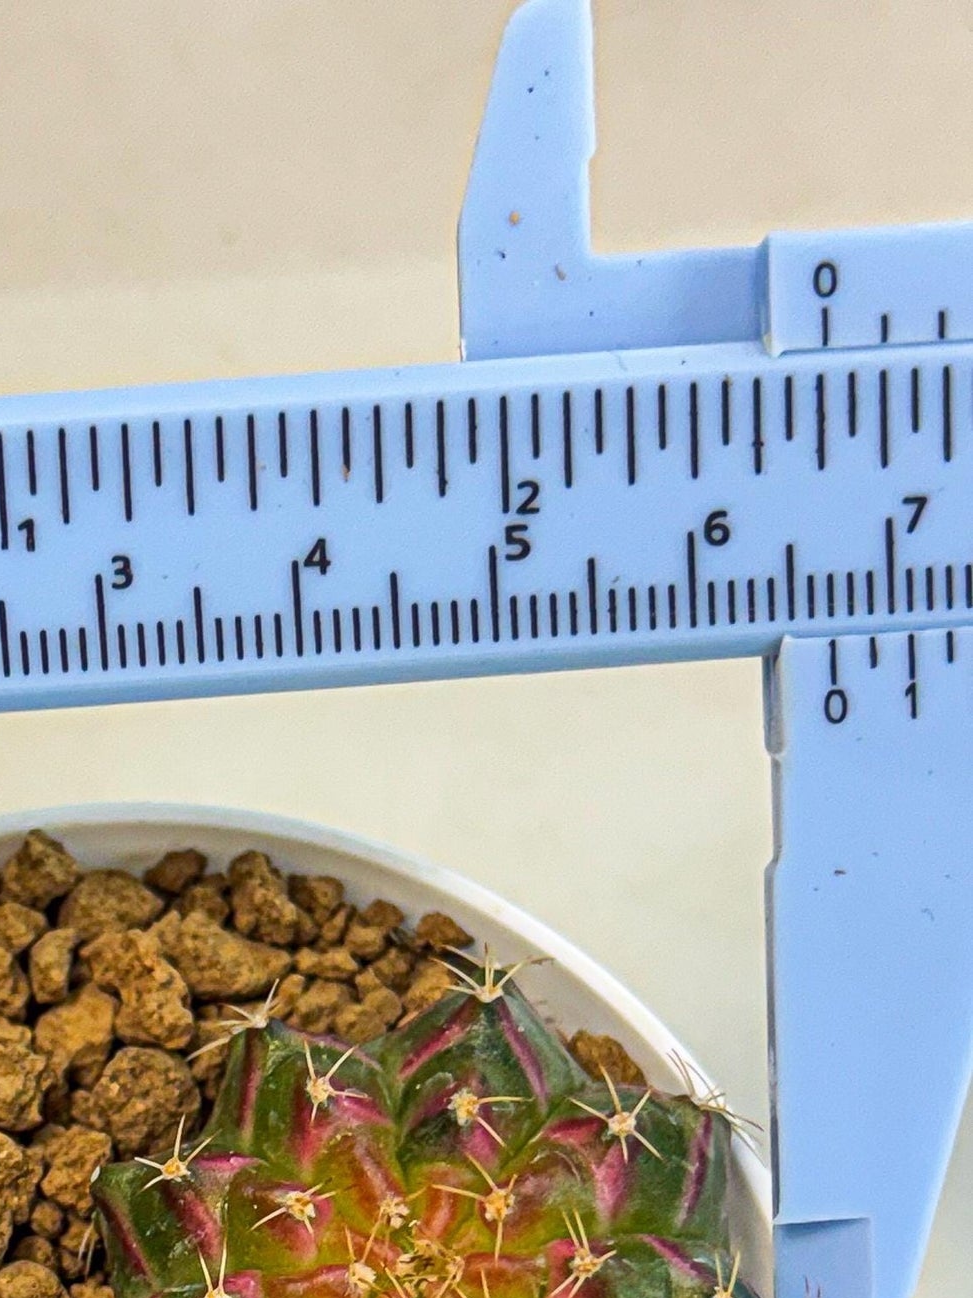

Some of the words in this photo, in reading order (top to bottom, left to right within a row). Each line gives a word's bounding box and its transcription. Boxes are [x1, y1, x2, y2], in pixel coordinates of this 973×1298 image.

[812, 261, 838, 298] 0
[18, 519, 36, 552] 1
[515, 481, 540, 514] 2
[110, 555, 133, 589] 3
[303, 539, 331, 575] 4
[505, 525, 529, 561] 5
[704, 511, 730, 546] 6
[902, 496, 927, 533] 7
[824, 689, 848, 723] 0
[904, 682, 918, 719] 1
